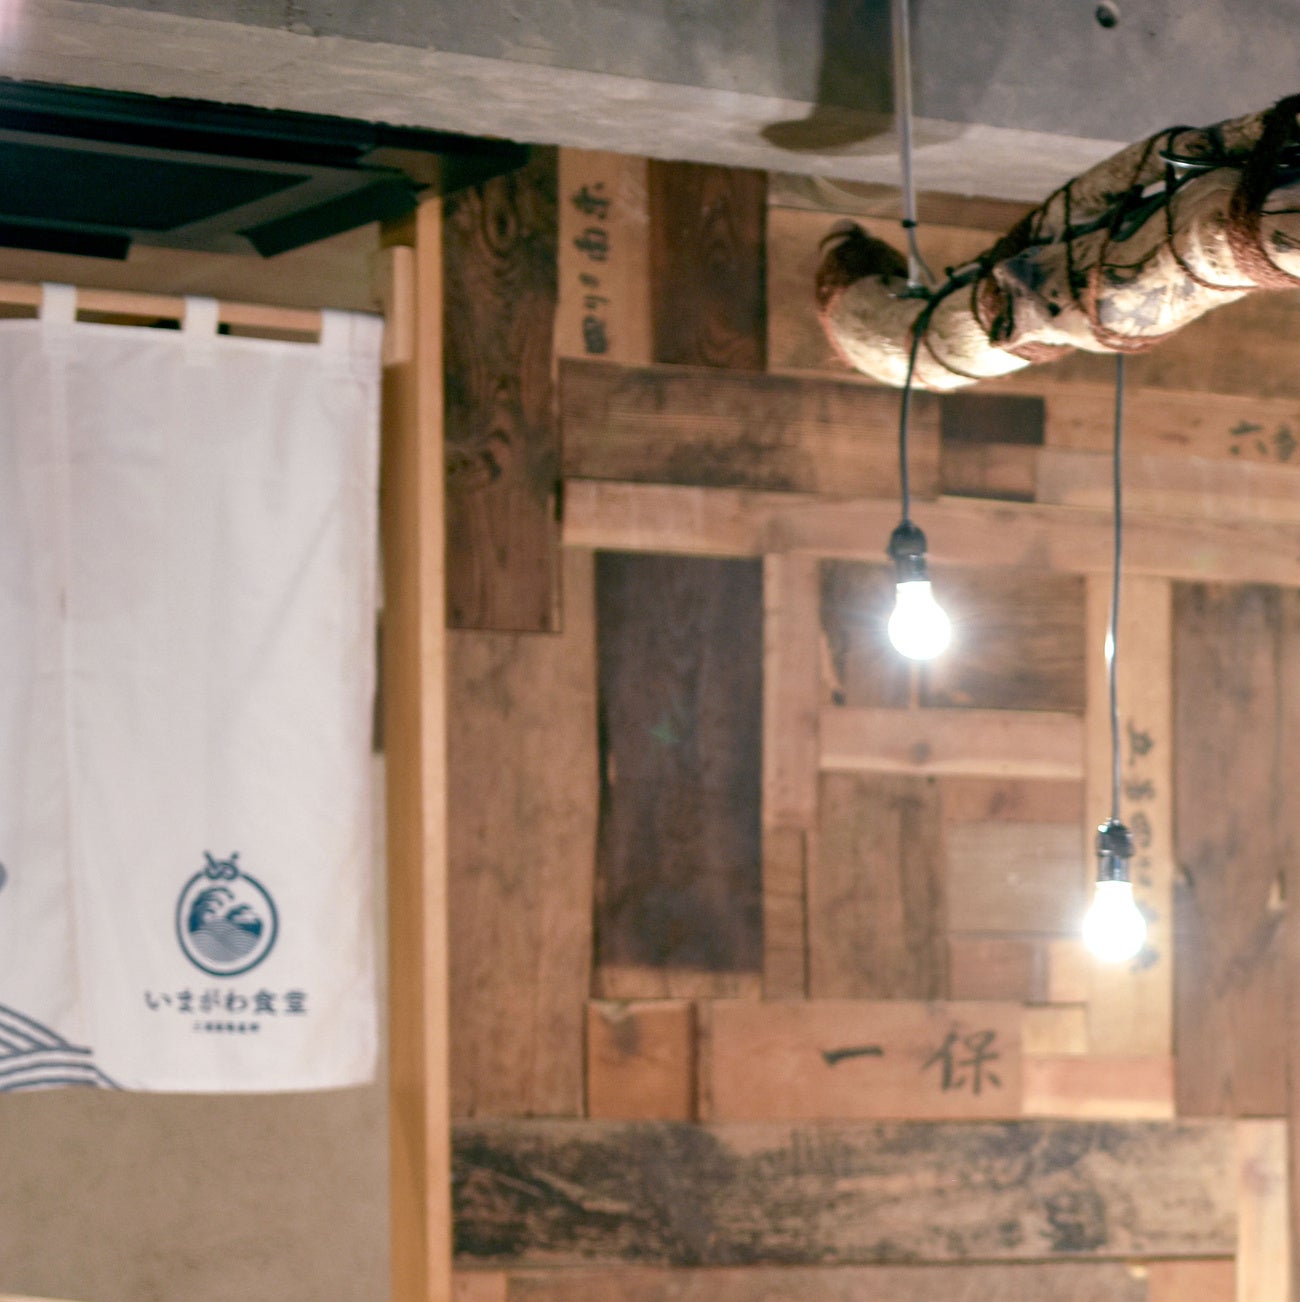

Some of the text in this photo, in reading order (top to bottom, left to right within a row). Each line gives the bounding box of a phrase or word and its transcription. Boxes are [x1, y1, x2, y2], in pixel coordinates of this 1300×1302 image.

[144, 990, 309, 1015] いまがわ食堂
